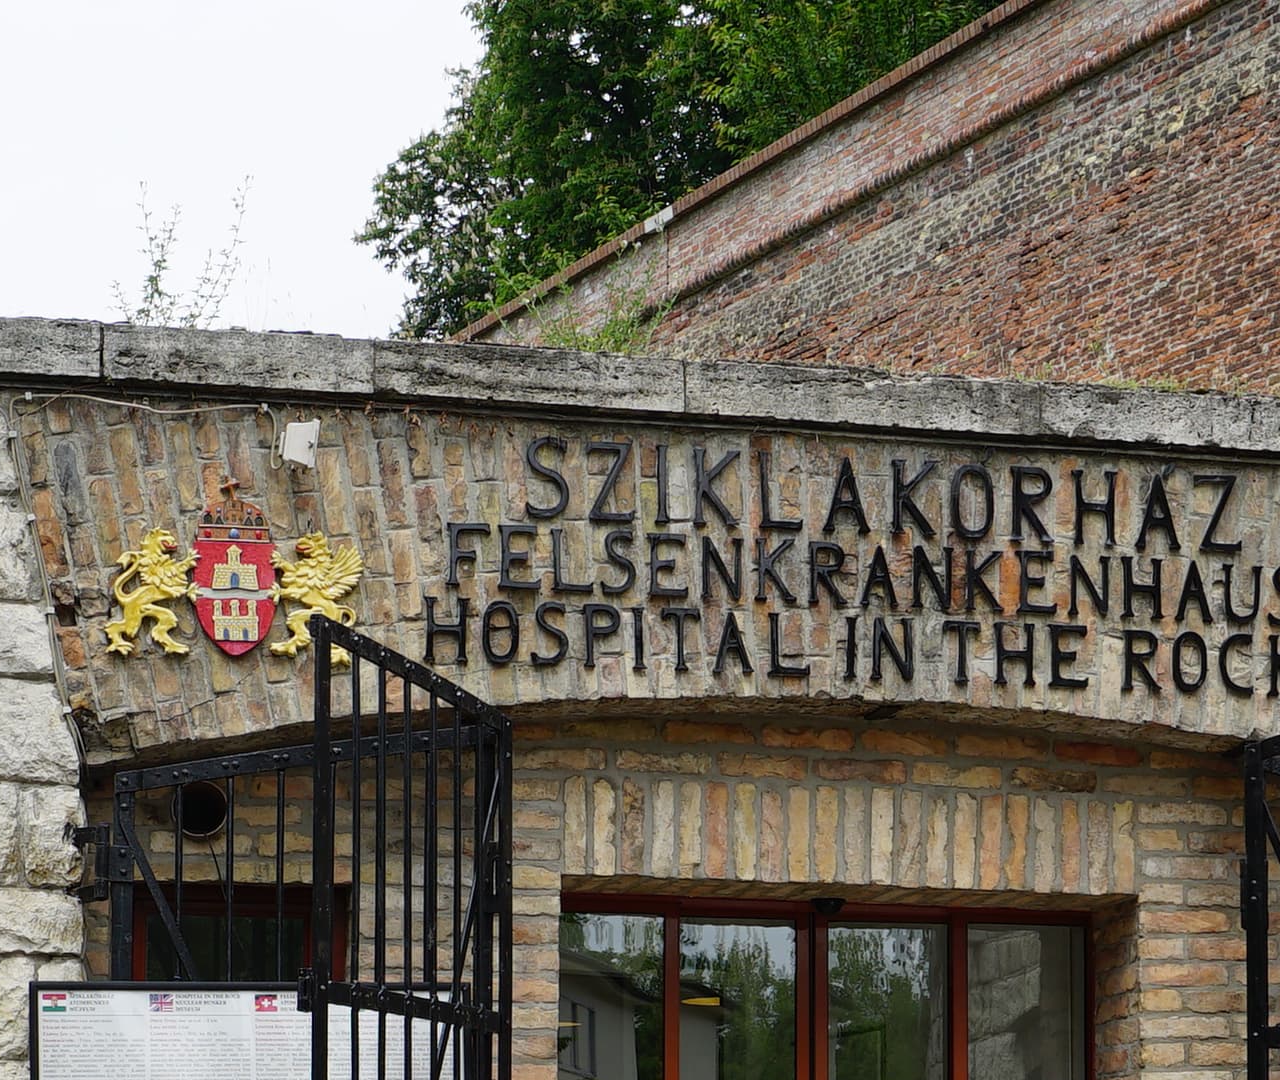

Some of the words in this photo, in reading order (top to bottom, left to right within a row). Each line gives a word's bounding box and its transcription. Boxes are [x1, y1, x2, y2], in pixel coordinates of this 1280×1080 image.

[526, 436, 1243, 553] SZIKLAKÓRHÁZ
[423, 596, 810, 677] HOSPITAL
[843, 615, 914, 682] IN
[942, 620, 1090, 690] THE
